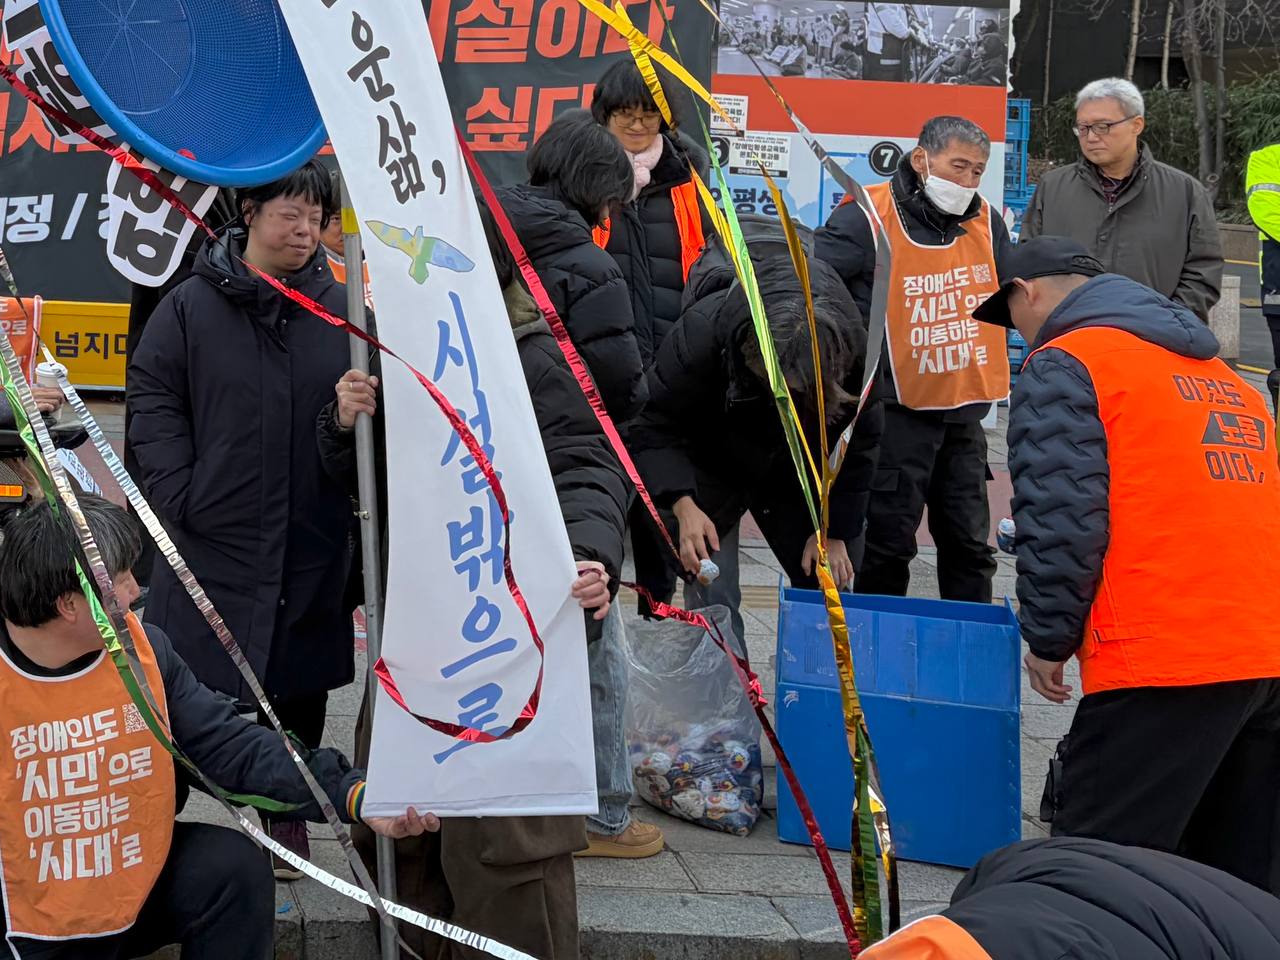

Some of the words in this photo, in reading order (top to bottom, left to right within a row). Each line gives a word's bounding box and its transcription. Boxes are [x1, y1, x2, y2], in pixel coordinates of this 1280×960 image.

[880, 148, 894, 168] 7
[910, 318, 980, 347] 이동하는
[1214, 413, 1263, 447] 노동
[9, 707, 121, 760] 장애인도
[22, 791, 131, 840] 이동하는
